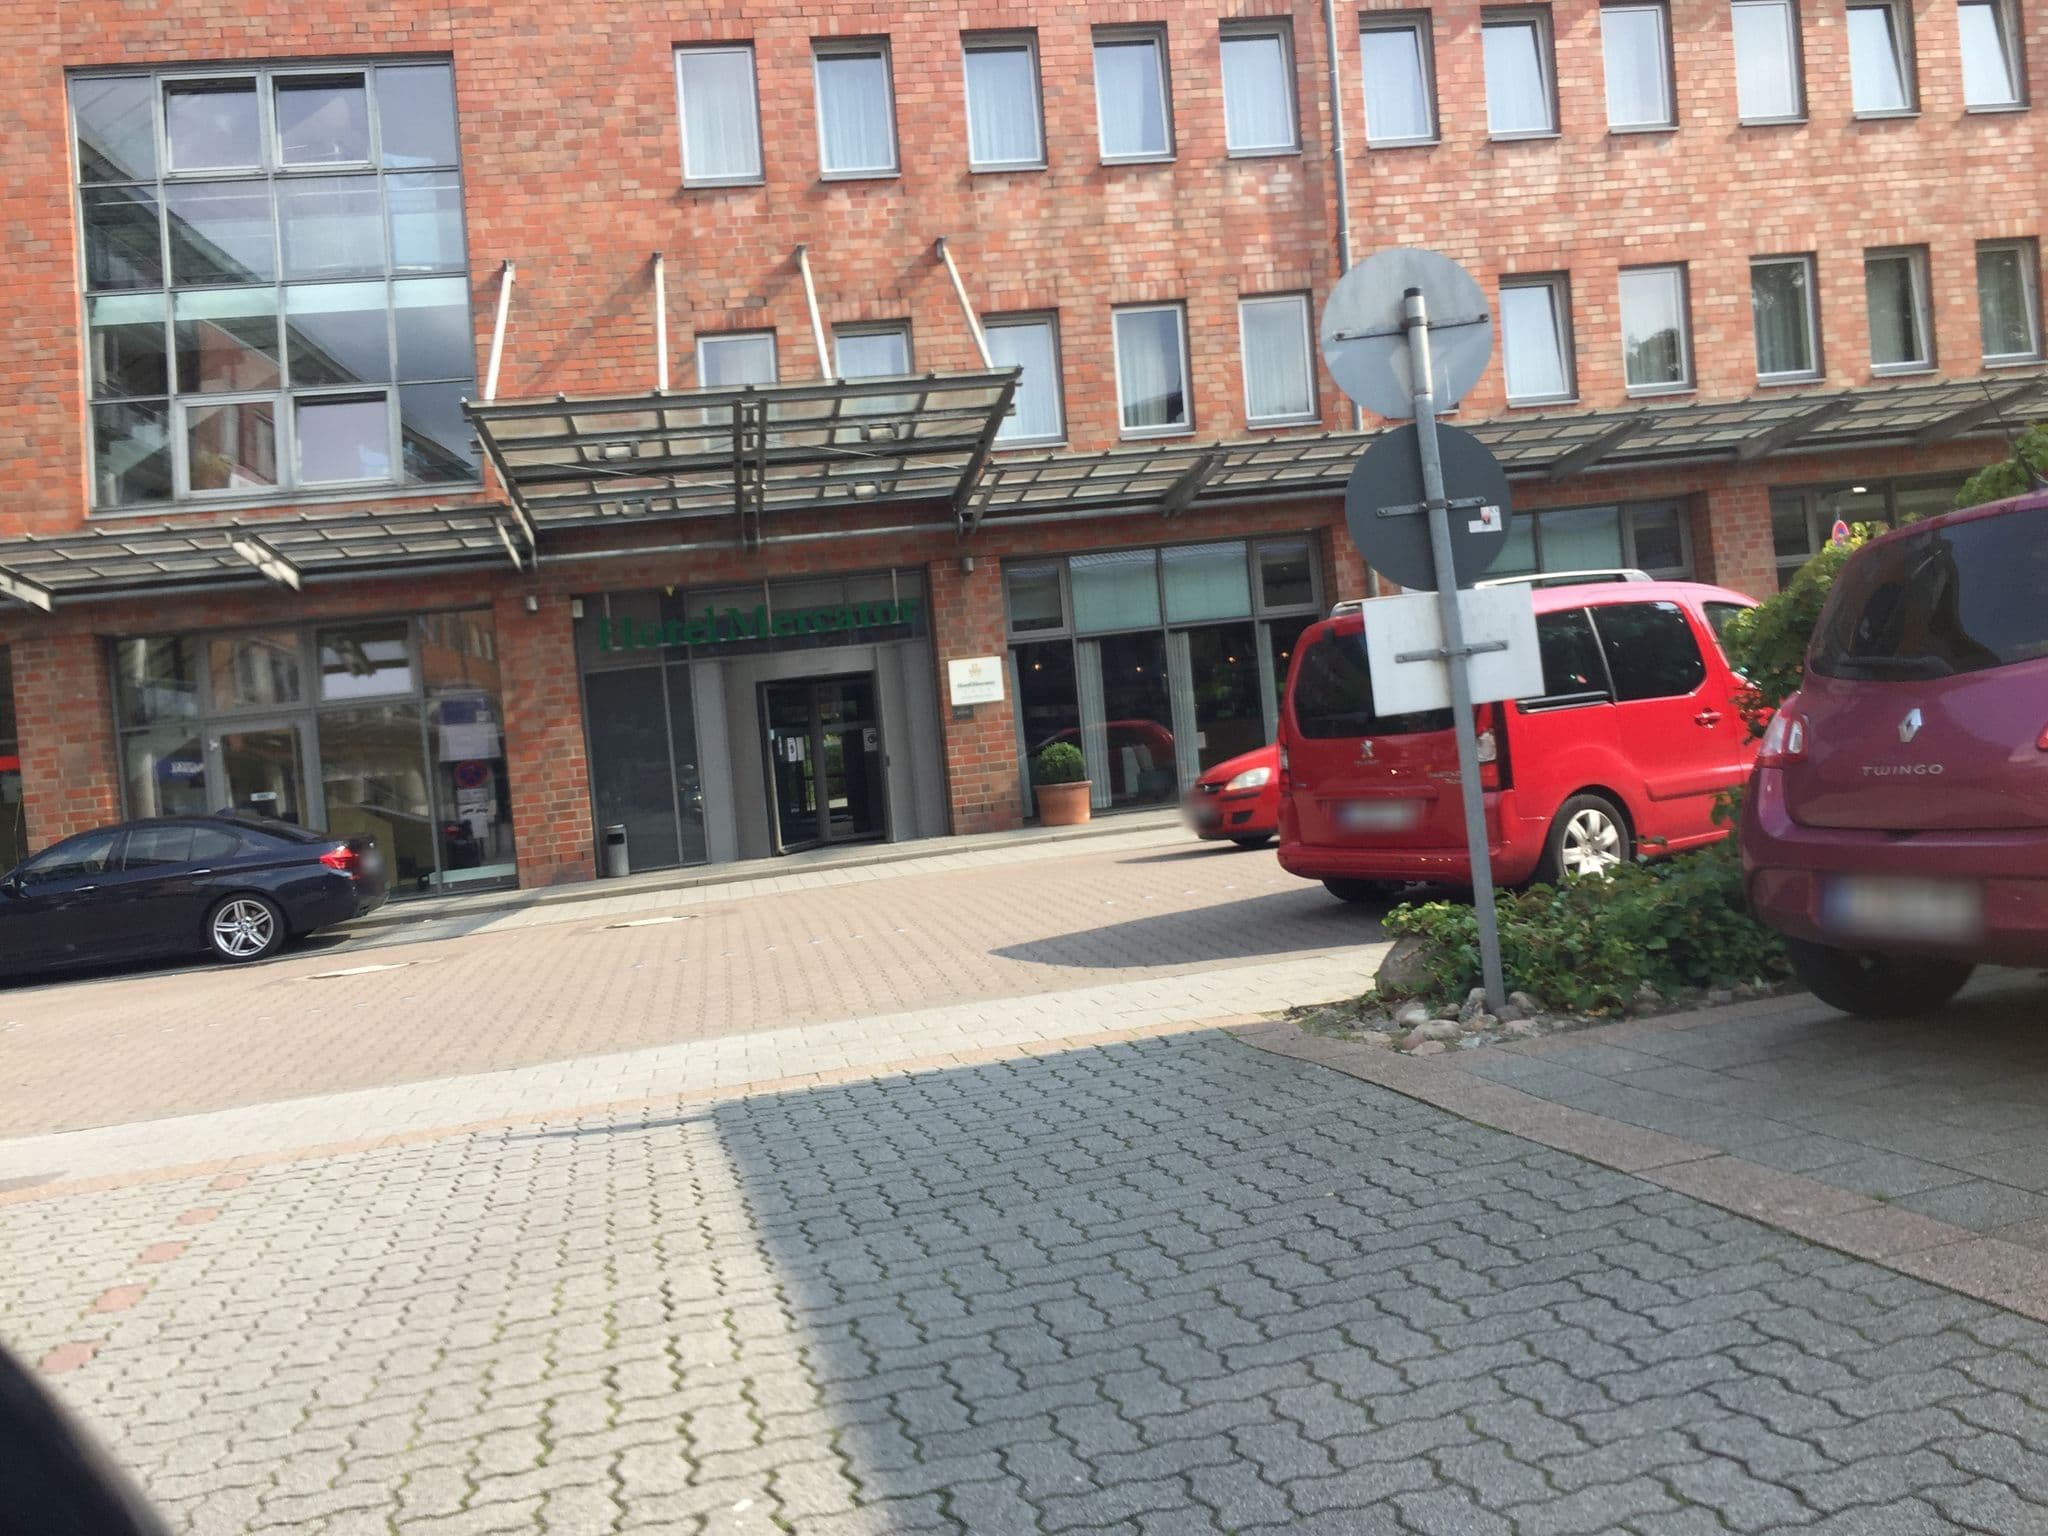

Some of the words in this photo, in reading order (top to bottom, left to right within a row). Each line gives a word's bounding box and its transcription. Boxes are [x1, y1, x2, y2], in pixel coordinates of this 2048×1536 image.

[599, 606, 718, 650] Hotel
[725, 598, 916, 638] Mercator
[1861, 764, 1943, 776] TWINGO
